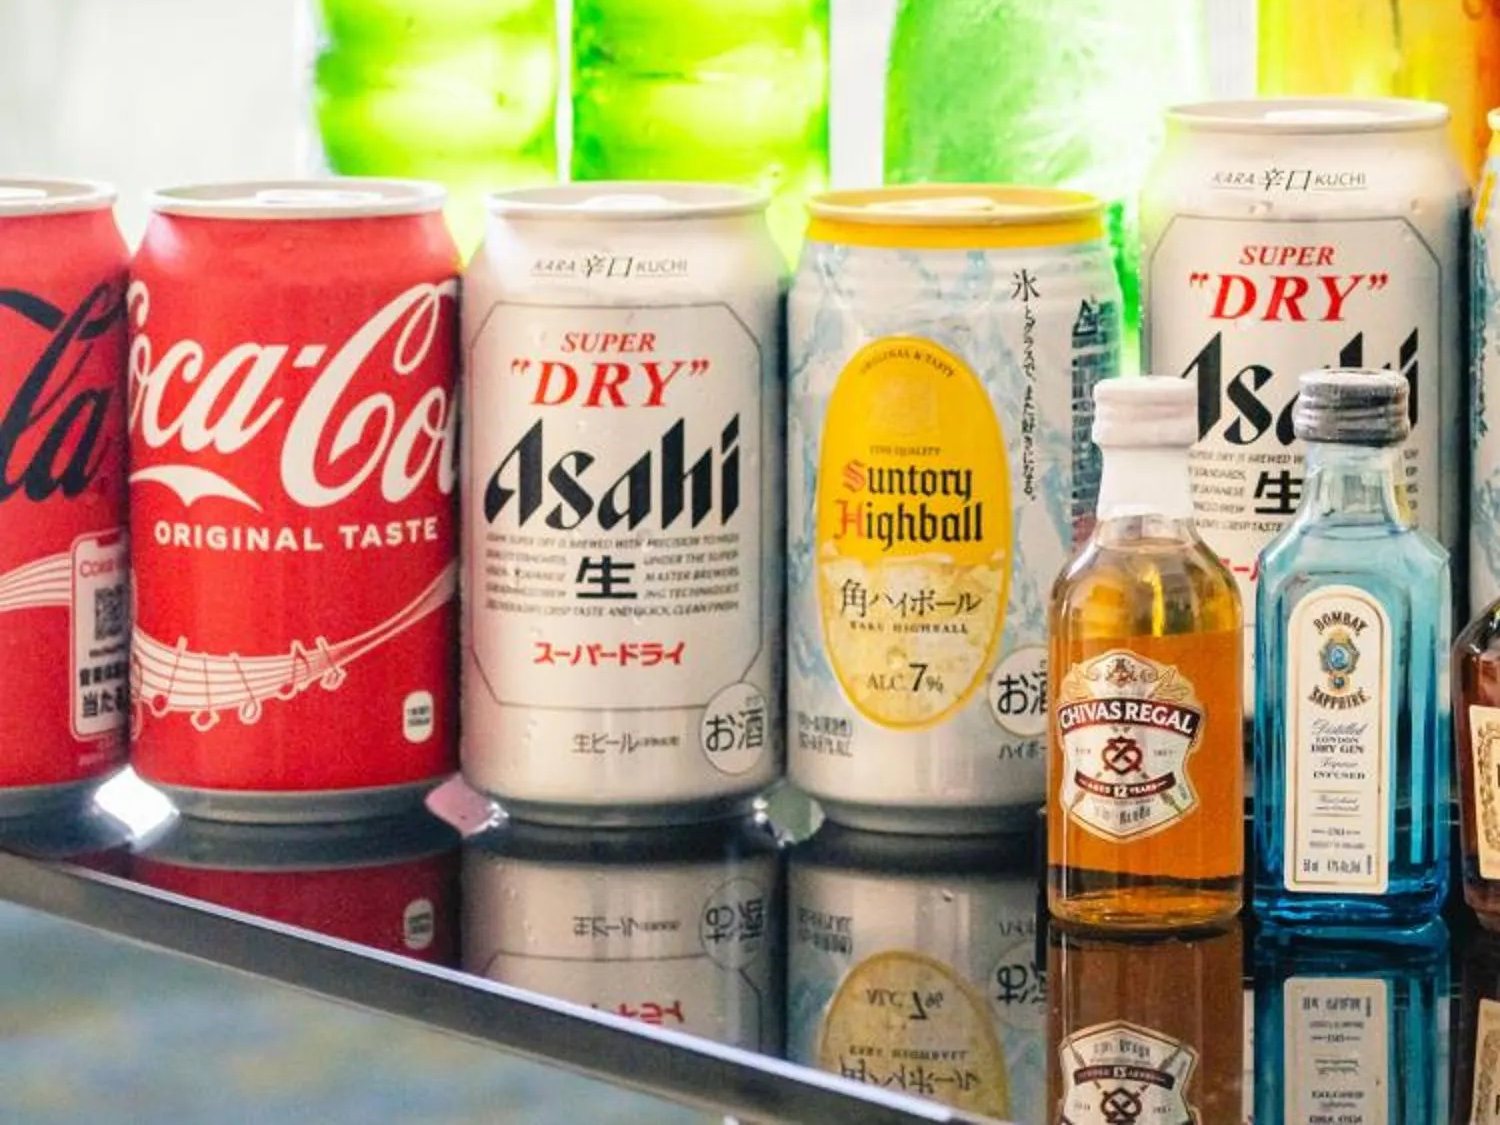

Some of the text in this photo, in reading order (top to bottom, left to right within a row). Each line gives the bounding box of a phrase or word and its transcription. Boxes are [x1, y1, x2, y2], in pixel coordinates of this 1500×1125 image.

[1261, 168, 1312, 192] 辛口
[1314, 171, 1367, 186] KUCHI
[581, 254, 633, 278] 辛口
[635, 259, 689, 274] KUCHI
[1239, 245, 1336, 267] SUPER
[561, 332, 657, 353] SUPER
[484, 412, 741, 532] Asahi
[842, 459, 974, 510] Suntory
[1254, 470, 1303, 514] 生
[154, 516, 440, 552] ORIGINAL TASTE
[834, 499, 984, 552] Highball
[576, 555, 639, 600] 生
[840, 578, 982, 618] 角ハイボール
[1312, 611, 1369, 637] BOMBAY
[533, 641, 686, 667] スーパードライ
[1306, 686, 1372, 711] SAPPHIRE
[705, 708, 765, 753] お酒
[1060, 701, 1194, 734] CHIVAS REGAL
[1113, 786, 1128, 798] 12
